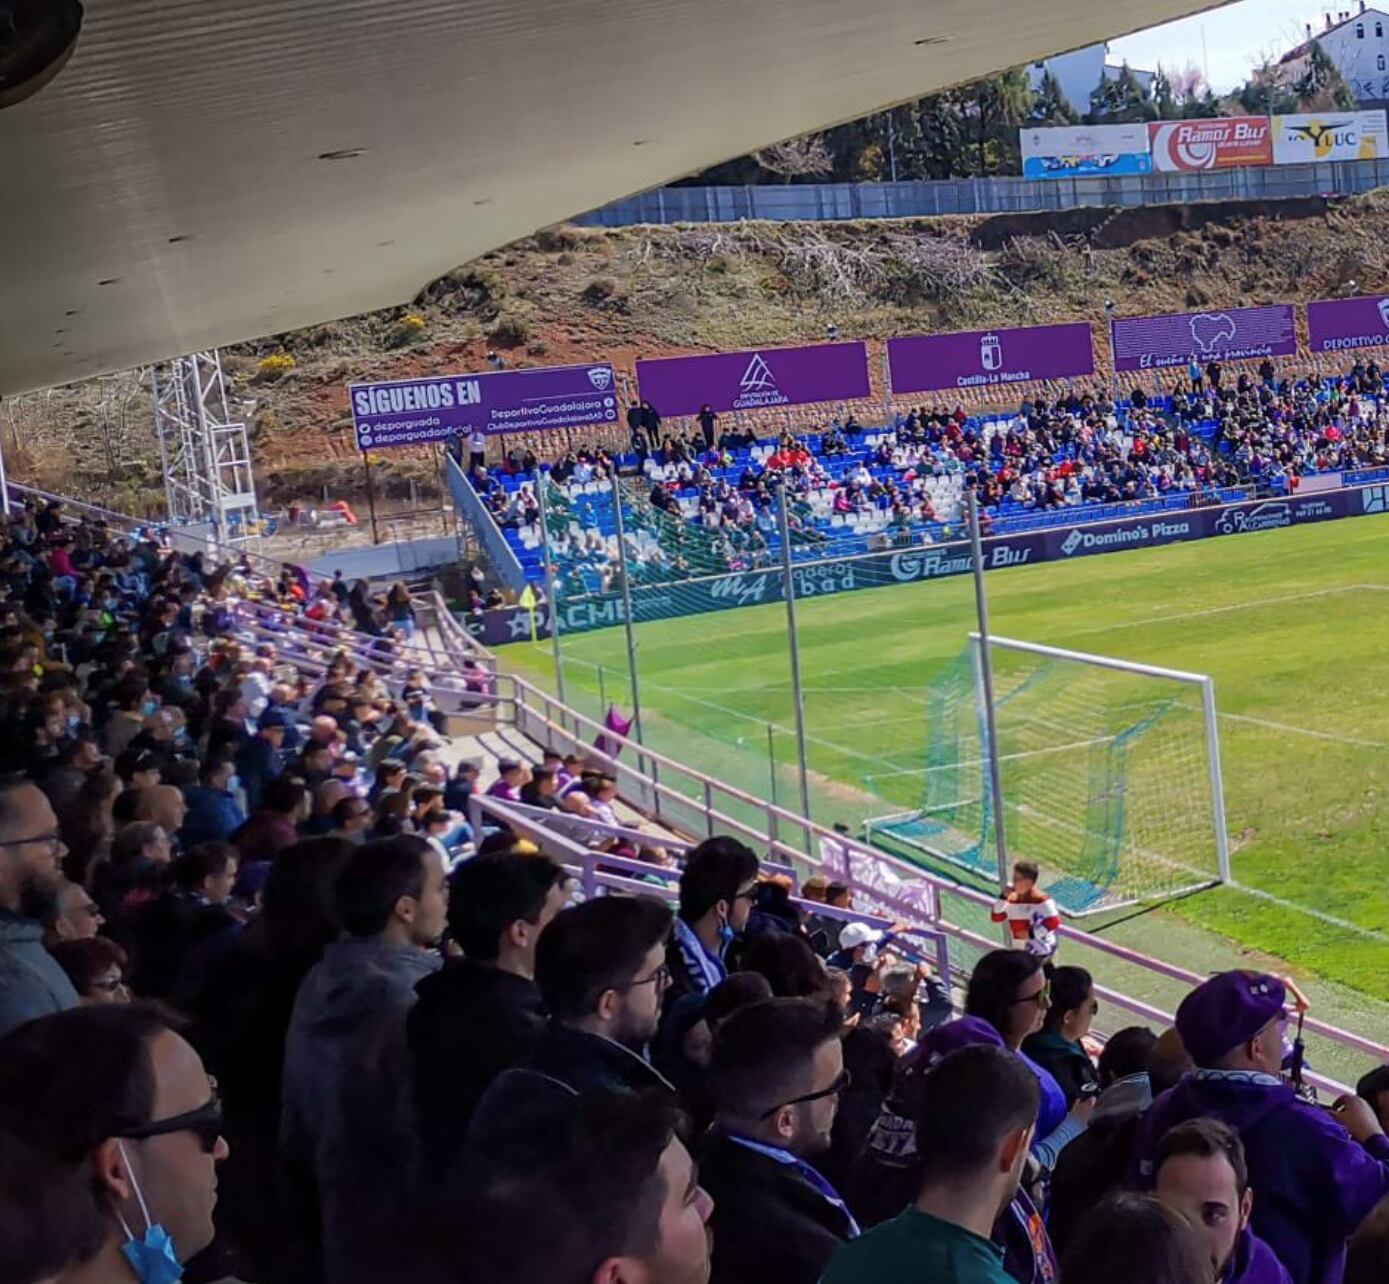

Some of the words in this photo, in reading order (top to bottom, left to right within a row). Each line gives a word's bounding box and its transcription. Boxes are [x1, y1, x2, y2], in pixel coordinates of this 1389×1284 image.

[1178, 126, 1231, 143] Ramos
[1234, 124, 1267, 139] Bus
[1323, 334, 1383, 350] DEPORTIVO
[1001, 370, 1031, 383] Mancha
[355, 382, 455, 416] SÍGUENOS
[456, 380, 481, 406] EN
[732, 395, 789, 409] GUADALAJARA
[491, 401, 601, 420] DeportivoGuadalajara
[373, 415, 441, 432] deporguada
[1082, 525, 1150, 547] Domino's
[1152, 521, 1190, 538] Pizza
[992, 546, 1032, 567] Bus
[781, 569, 854, 598] bad
